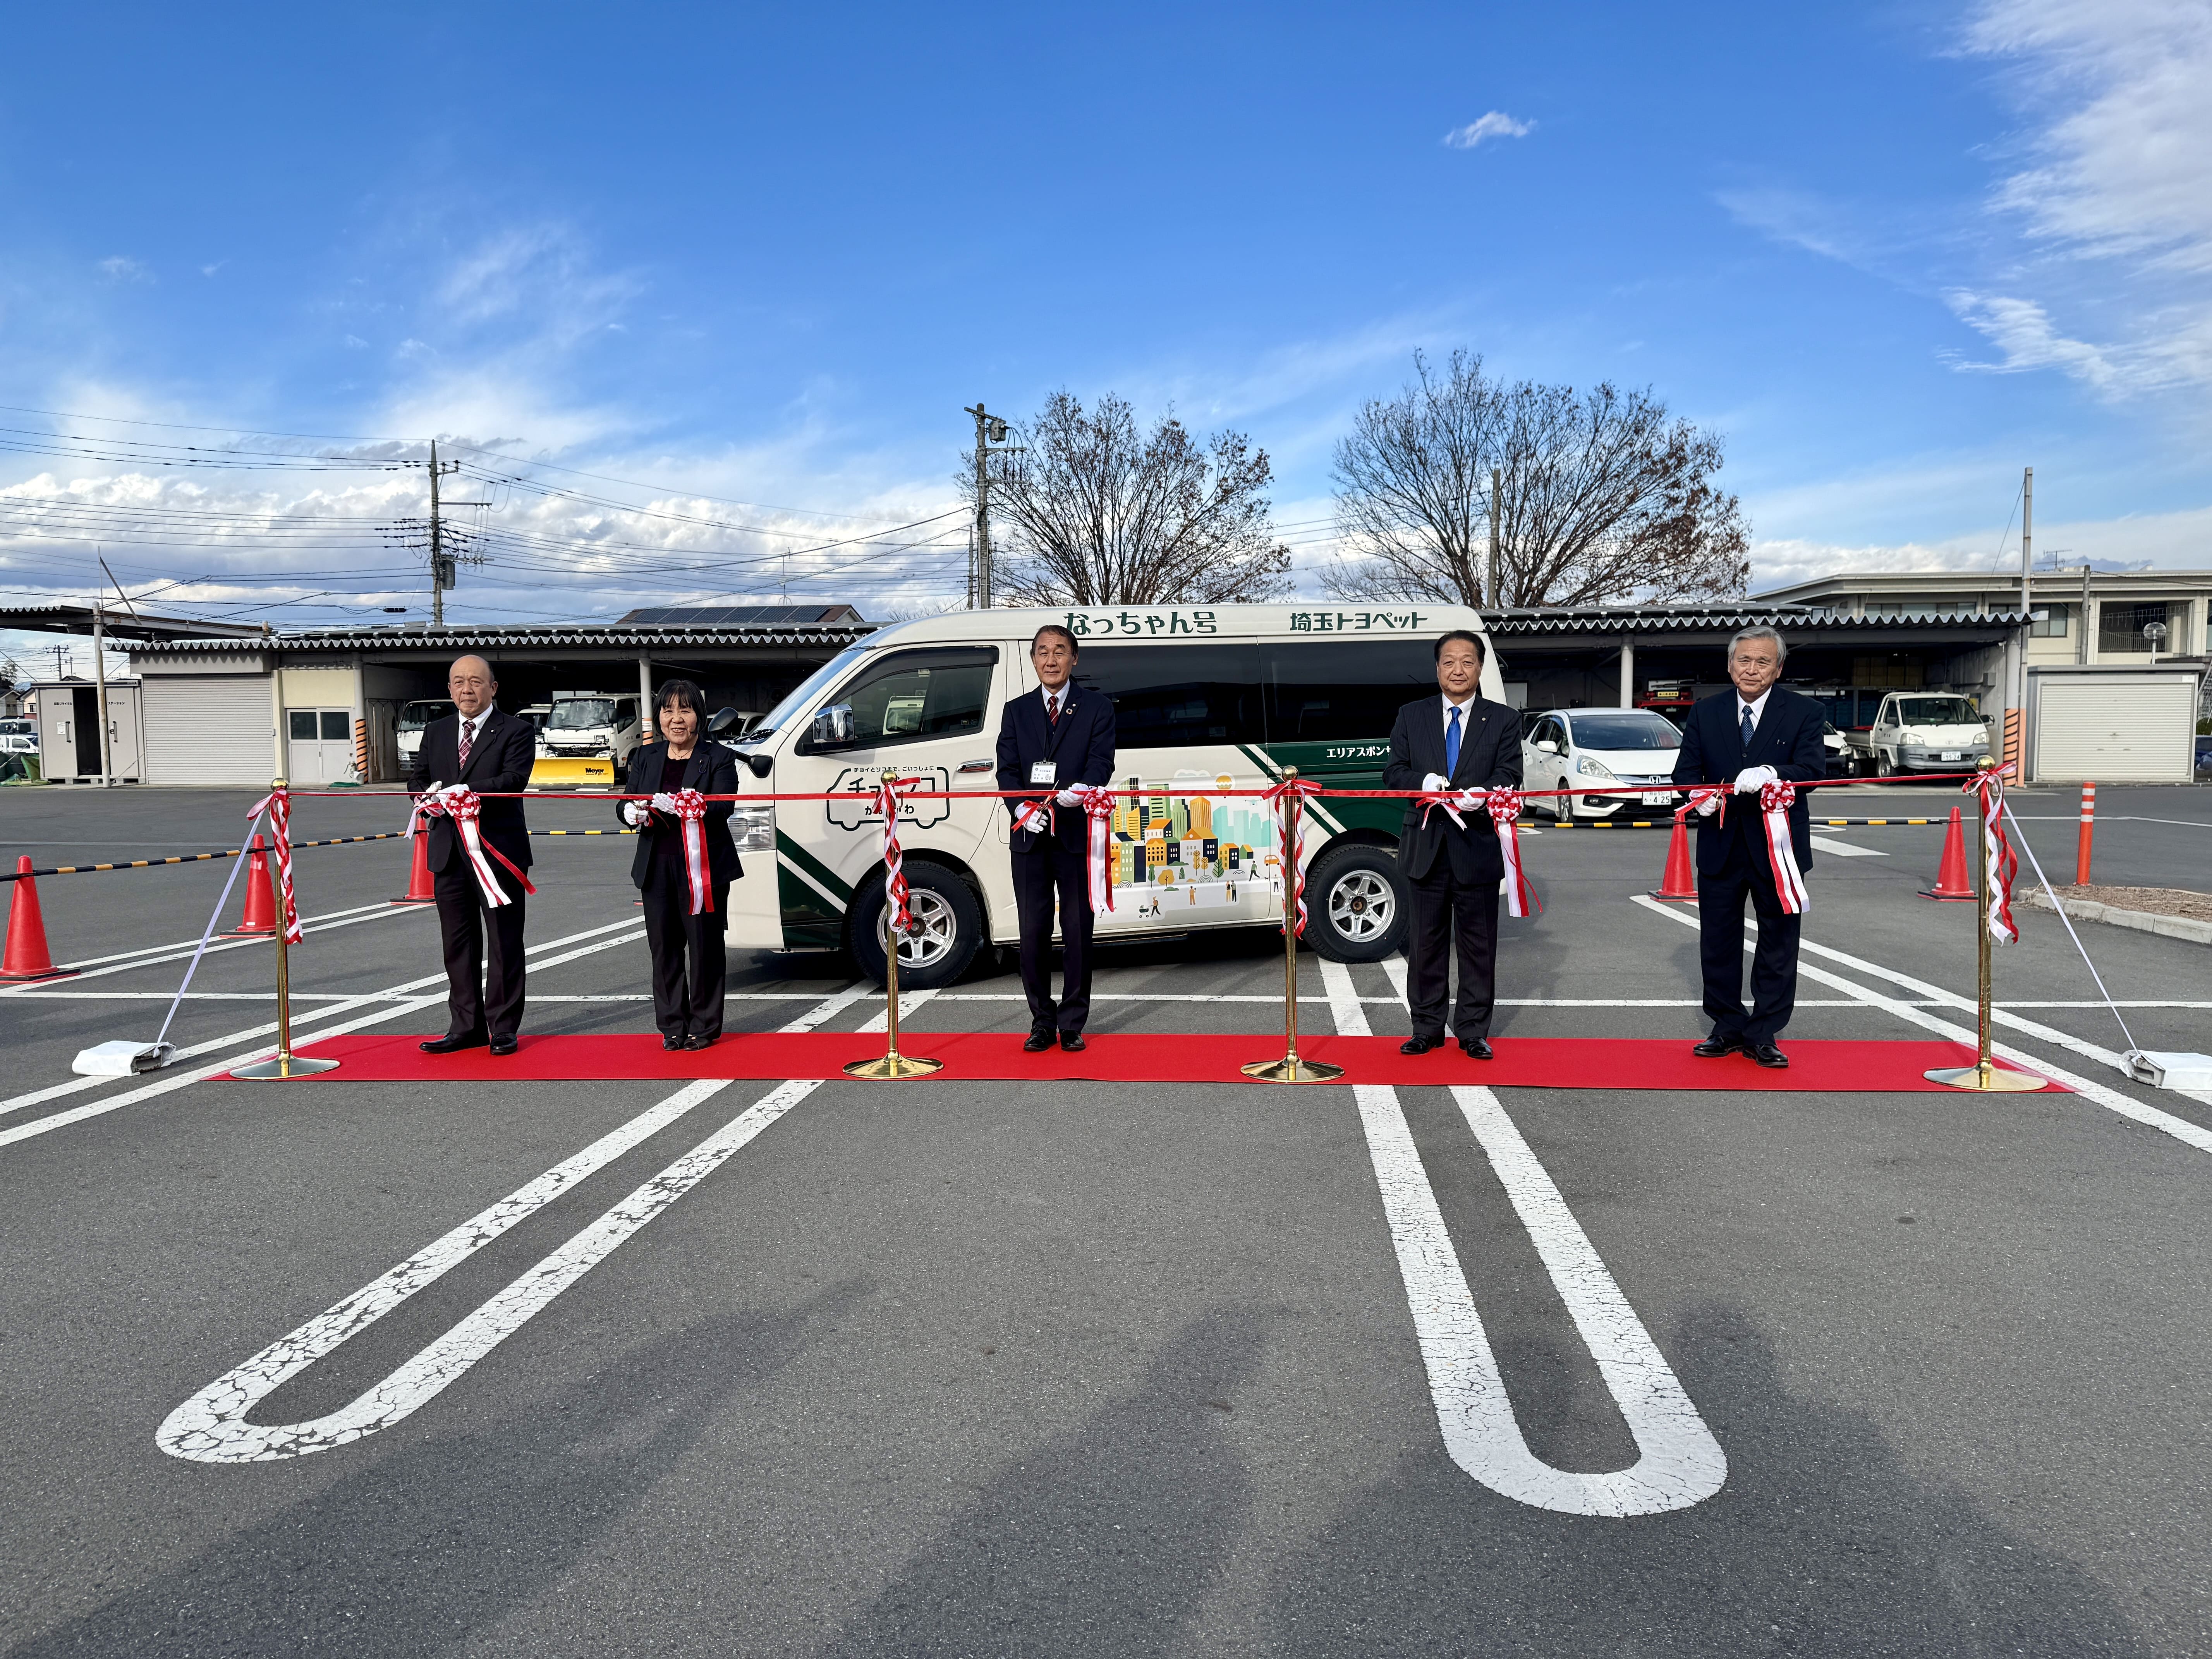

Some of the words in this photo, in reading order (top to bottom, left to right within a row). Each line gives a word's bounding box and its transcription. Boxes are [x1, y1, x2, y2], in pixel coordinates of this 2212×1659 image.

[1063, 611, 1217, 635] なっちゃん号
[1290, 612, 1428, 632] 埼玉トヨペット
